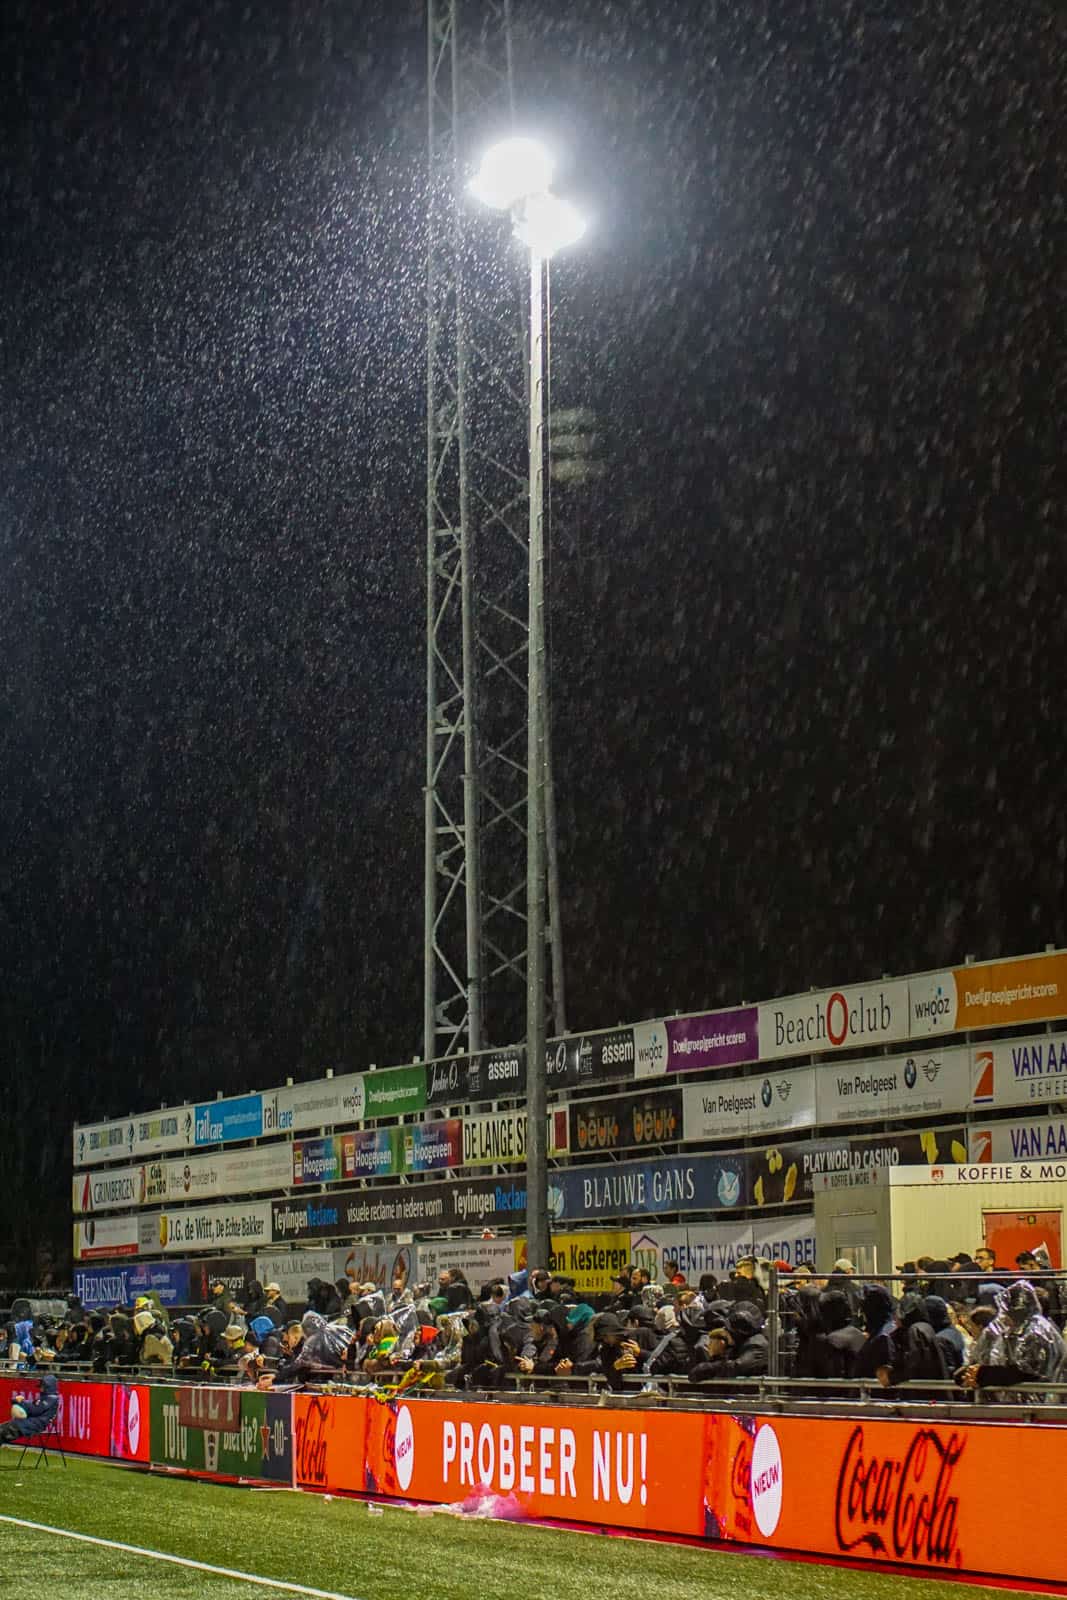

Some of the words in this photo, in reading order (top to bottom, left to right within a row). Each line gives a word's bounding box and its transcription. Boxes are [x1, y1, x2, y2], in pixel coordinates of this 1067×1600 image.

[601, 1039, 634, 1065] assem
[1012, 1045, 1043, 1077] VAN
[487, 1059, 519, 1080] assem
[837, 1075, 853, 1096] Van
[854, 1072, 897, 1096] Poelgeest
[702, 1098, 717, 1113] Van
[718, 1094, 757, 1114] Poelgeest
[464, 1122, 477, 1161] DE
[479, 1116, 513, 1159] LANGE
[1010, 1126, 1042, 1158] VAN
[863, 1147, 900, 1168] CASINO
[958, 1165, 1012, 1180] KOFFIE
[1020, 1164, 1032, 1179] &
[583, 1173, 645, 1209] BLAUWE
[653, 1167, 696, 1202] GANS
[169, 1220, 183, 1241] J.G.
[185, 1218, 195, 1238] de
[216, 1217, 225, 1238] De
[242, 1214, 264, 1236] Bakker
[550, 1252, 566, 1271] an
[570, 1244, 628, 1271] Kesteren
[795, 1238, 816, 1264] BE
[76, 1272, 128, 1305] HEEMSKERK
[69, 1396, 91, 1439] NU!
[442, 1420, 577, 1498] PROBEER
[593, 1429, 648, 1506] NU!
[754, 1462, 780, 1496] NIEUW
